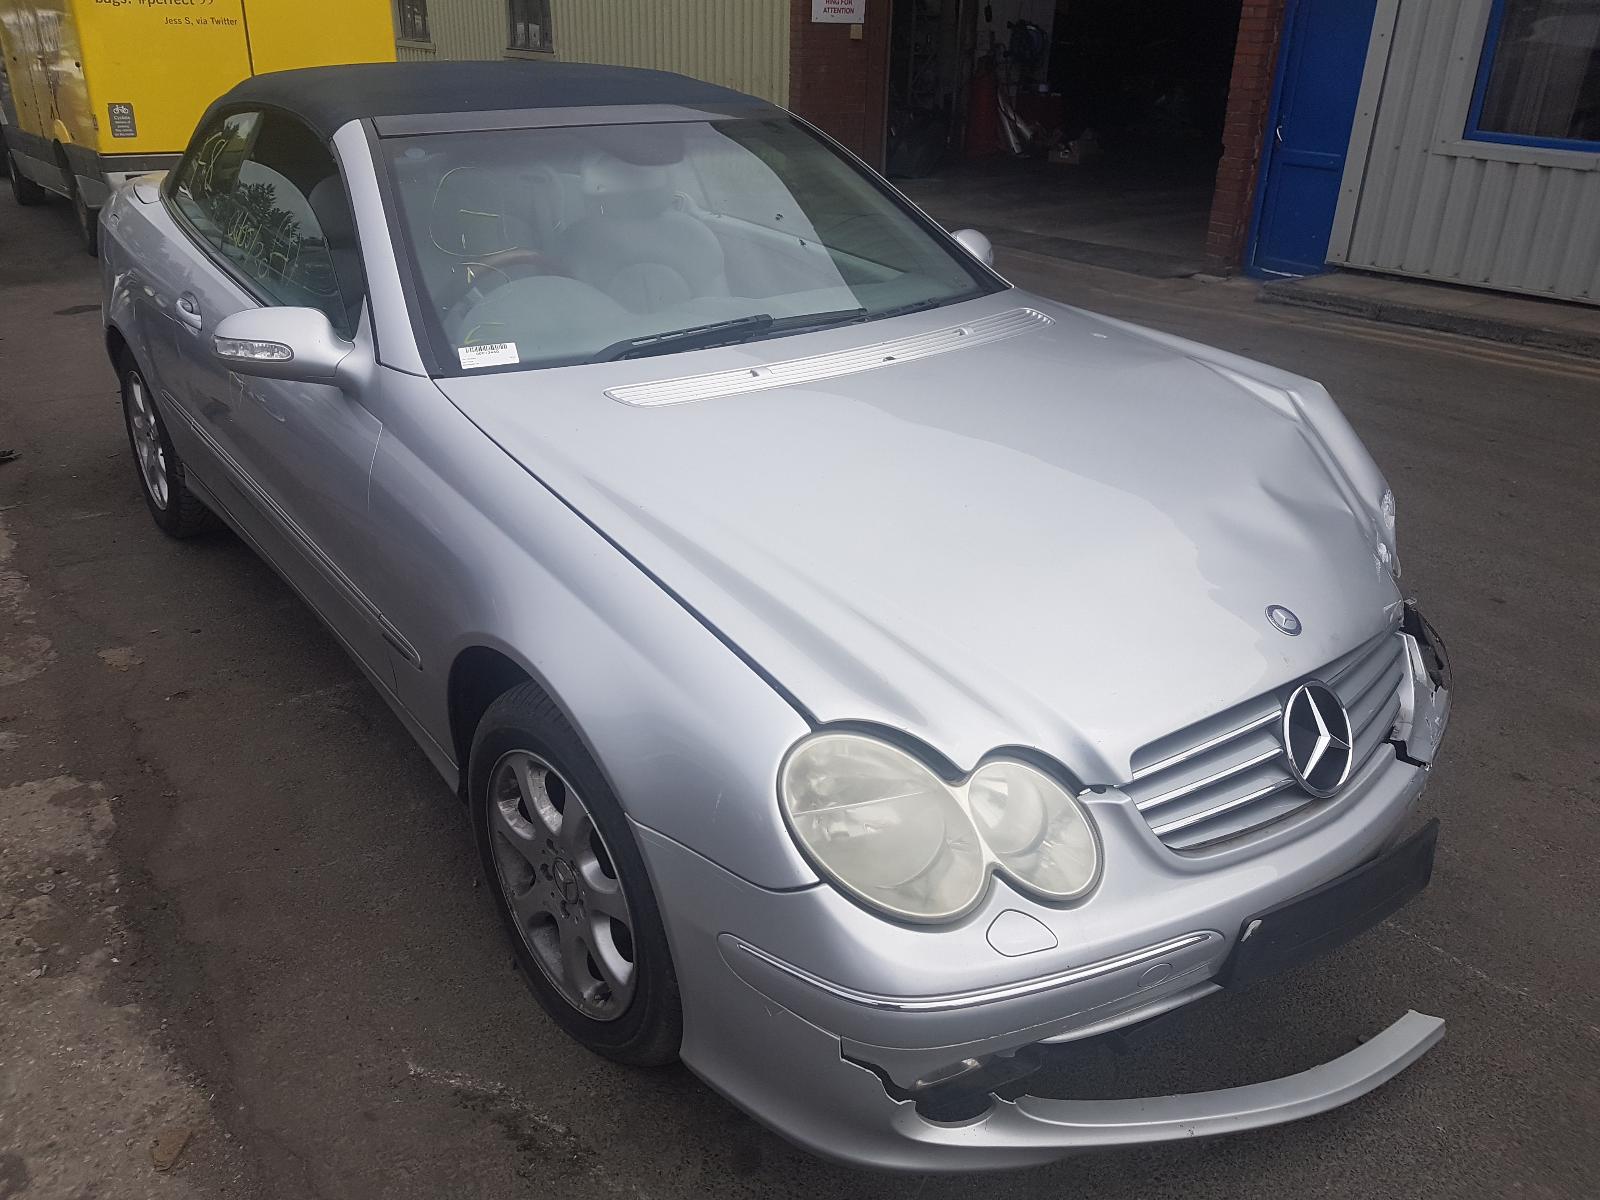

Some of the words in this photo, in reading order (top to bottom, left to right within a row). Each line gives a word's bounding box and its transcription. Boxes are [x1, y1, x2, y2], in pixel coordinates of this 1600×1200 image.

[164, 16, 182, 25] Jess
[184, 16, 194, 26] S,
[196, 17, 208, 25] via
[210, 17, 238, 26] Twitter
